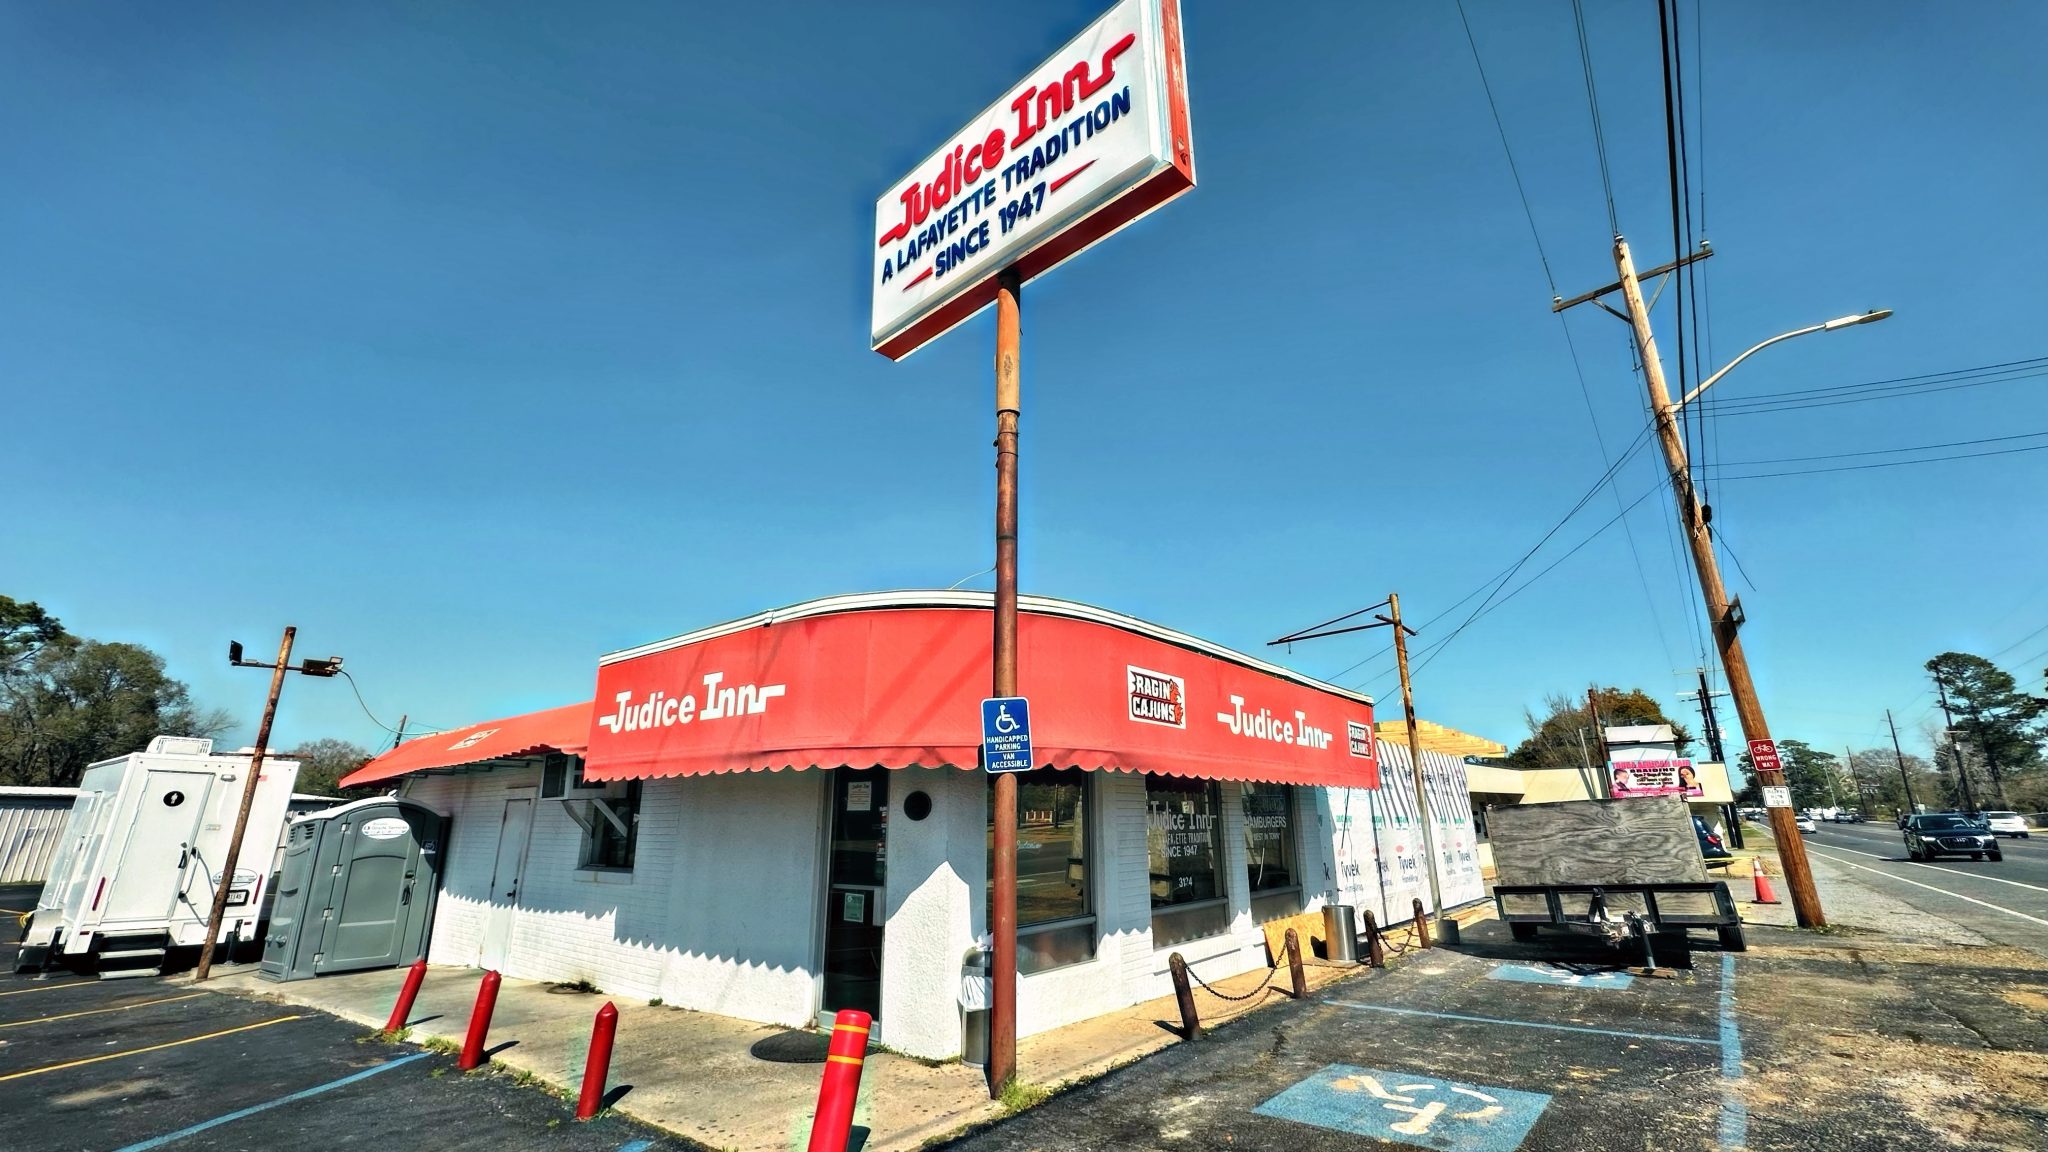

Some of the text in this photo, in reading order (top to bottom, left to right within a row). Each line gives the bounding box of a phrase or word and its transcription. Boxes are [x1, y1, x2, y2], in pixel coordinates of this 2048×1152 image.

[879, 128, 1005, 247] Judice
[882, 85, 1132, 285] A LAFAYETTE TRADITION
[935, 181, 1046, 277] SINCE 1947
[599, 690, 695, 735] Judice
[1132, 696, 1177, 722] CAJUNS
[1217, 694, 1294, 744] Judice
[986, 734, 1029, 744] HANDICAPPED
[994, 743, 1021, 751] PARKING
[991, 759, 1028, 769] ACCESSIBLE
[1002, 752, 1015, 760] VAN
[1148, 800, 1185, 831] Judice
[1161, 844, 1198, 858] SINCE 1947
[1398, 854, 1417, 874] Tyvek
